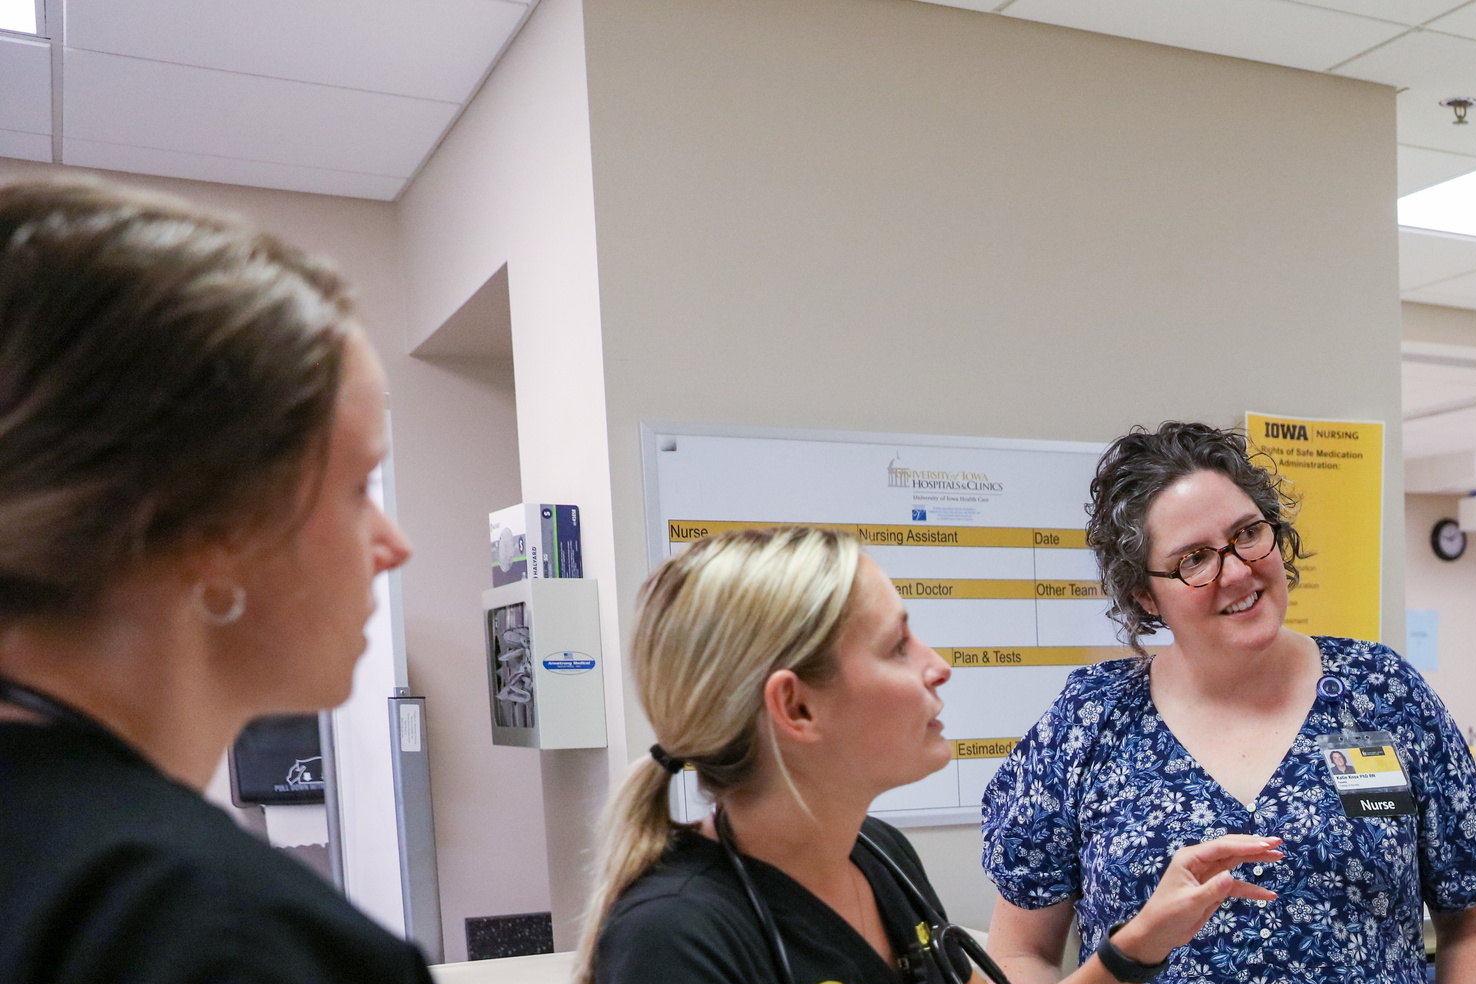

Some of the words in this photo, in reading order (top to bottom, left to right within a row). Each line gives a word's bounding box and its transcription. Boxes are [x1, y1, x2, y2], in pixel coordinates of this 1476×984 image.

[1265, 422, 1308, 441] IOWA
[1316, 430, 1359, 440] NURSING
[1286, 447, 1294, 456] of
[1296, 448, 1314, 457] Safe
[1316, 450, 1363, 459] Medication
[1279, 459, 1341, 470] Administration:
[670, 524, 708, 539] Nurse
[859, 528, 904, 545] Nursing
[906, 529, 958, 543] Assistant
[1035, 532, 1060, 545] Date
[916, 583, 953, 596] Doctor
[1036, 583, 1065, 596] Other
[1069, 584, 1097, 596] Team
[954, 651, 978, 664] Plan
[982, 651, 990, 663] &
[993, 650, 1022, 663] Tests
[958, 742, 1012, 756] Estimated
[1360, 799, 1396, 811] Nurse
